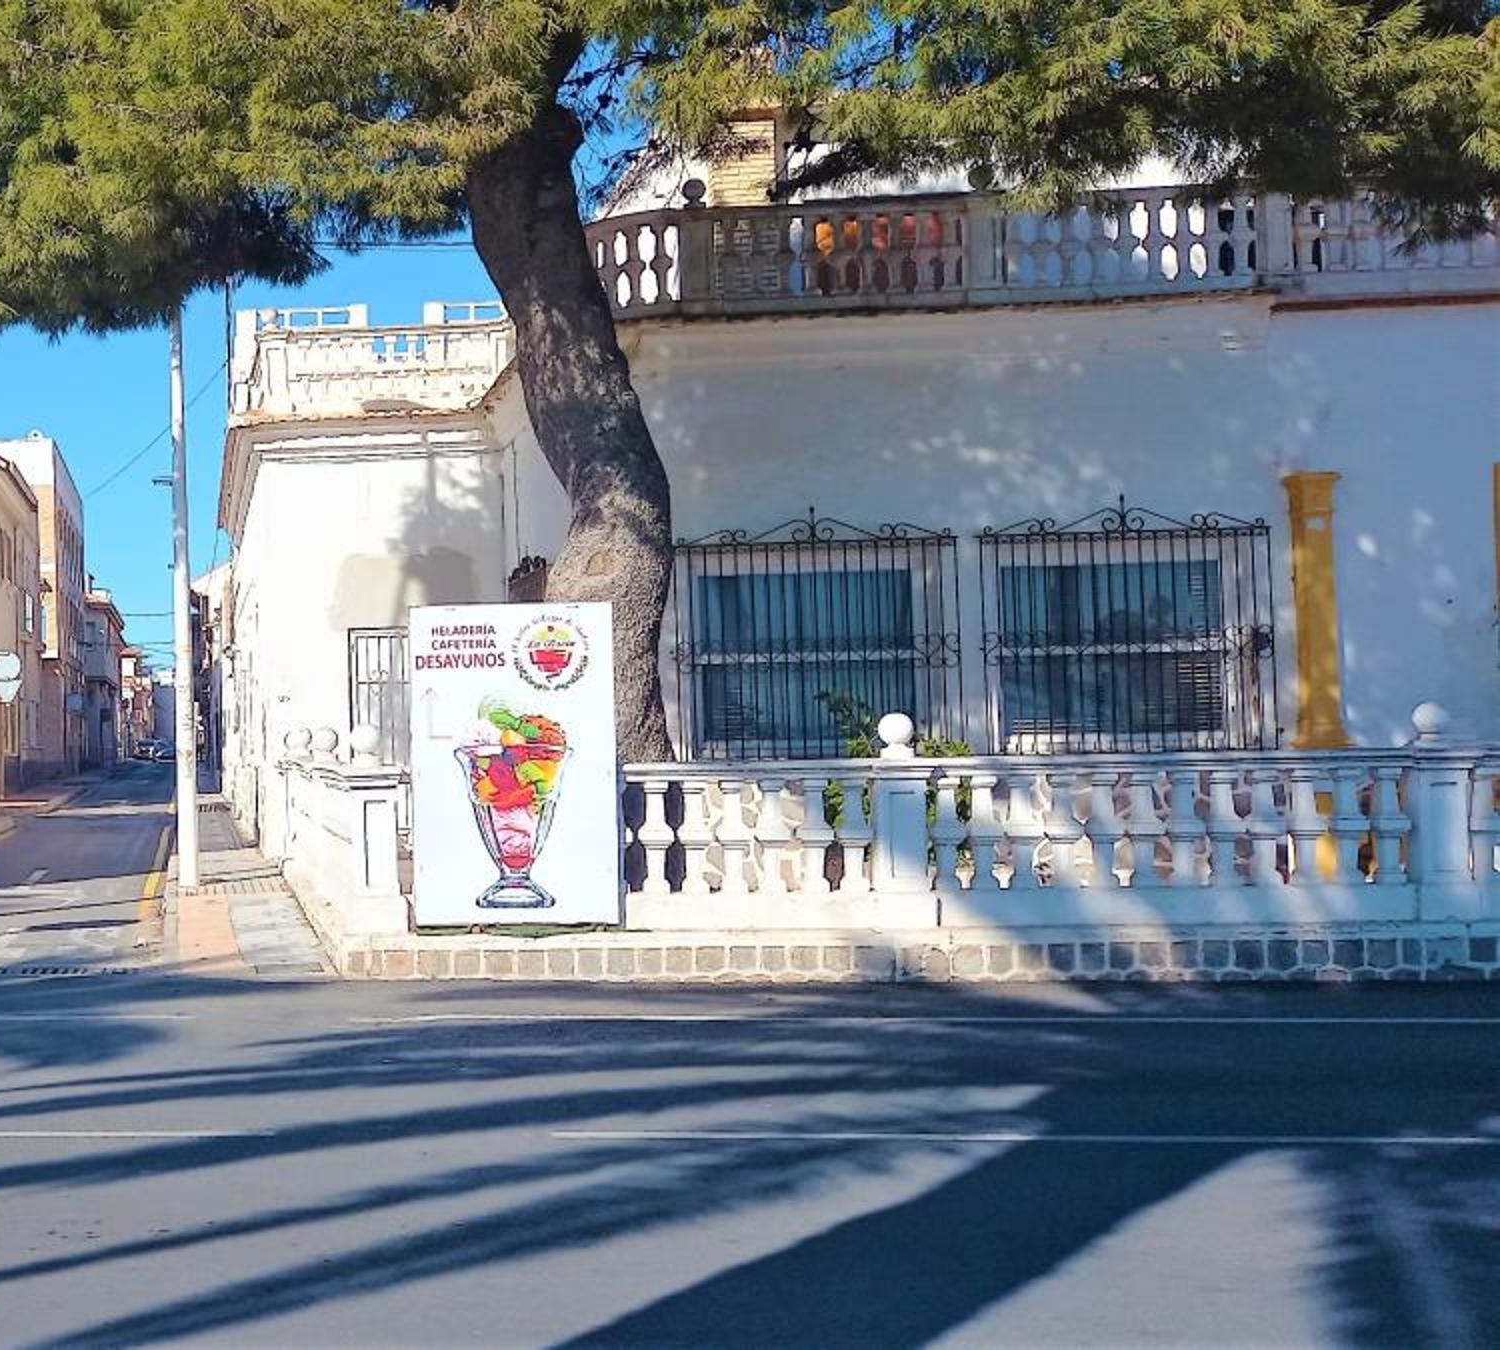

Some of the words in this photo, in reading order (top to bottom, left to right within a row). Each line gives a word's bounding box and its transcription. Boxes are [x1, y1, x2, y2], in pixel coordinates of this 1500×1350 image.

[431, 624, 496, 637] HELADERÍA
[431, 637, 496, 650] CAFETERÍA
[415, 652, 506, 670] DESAYUNOS
